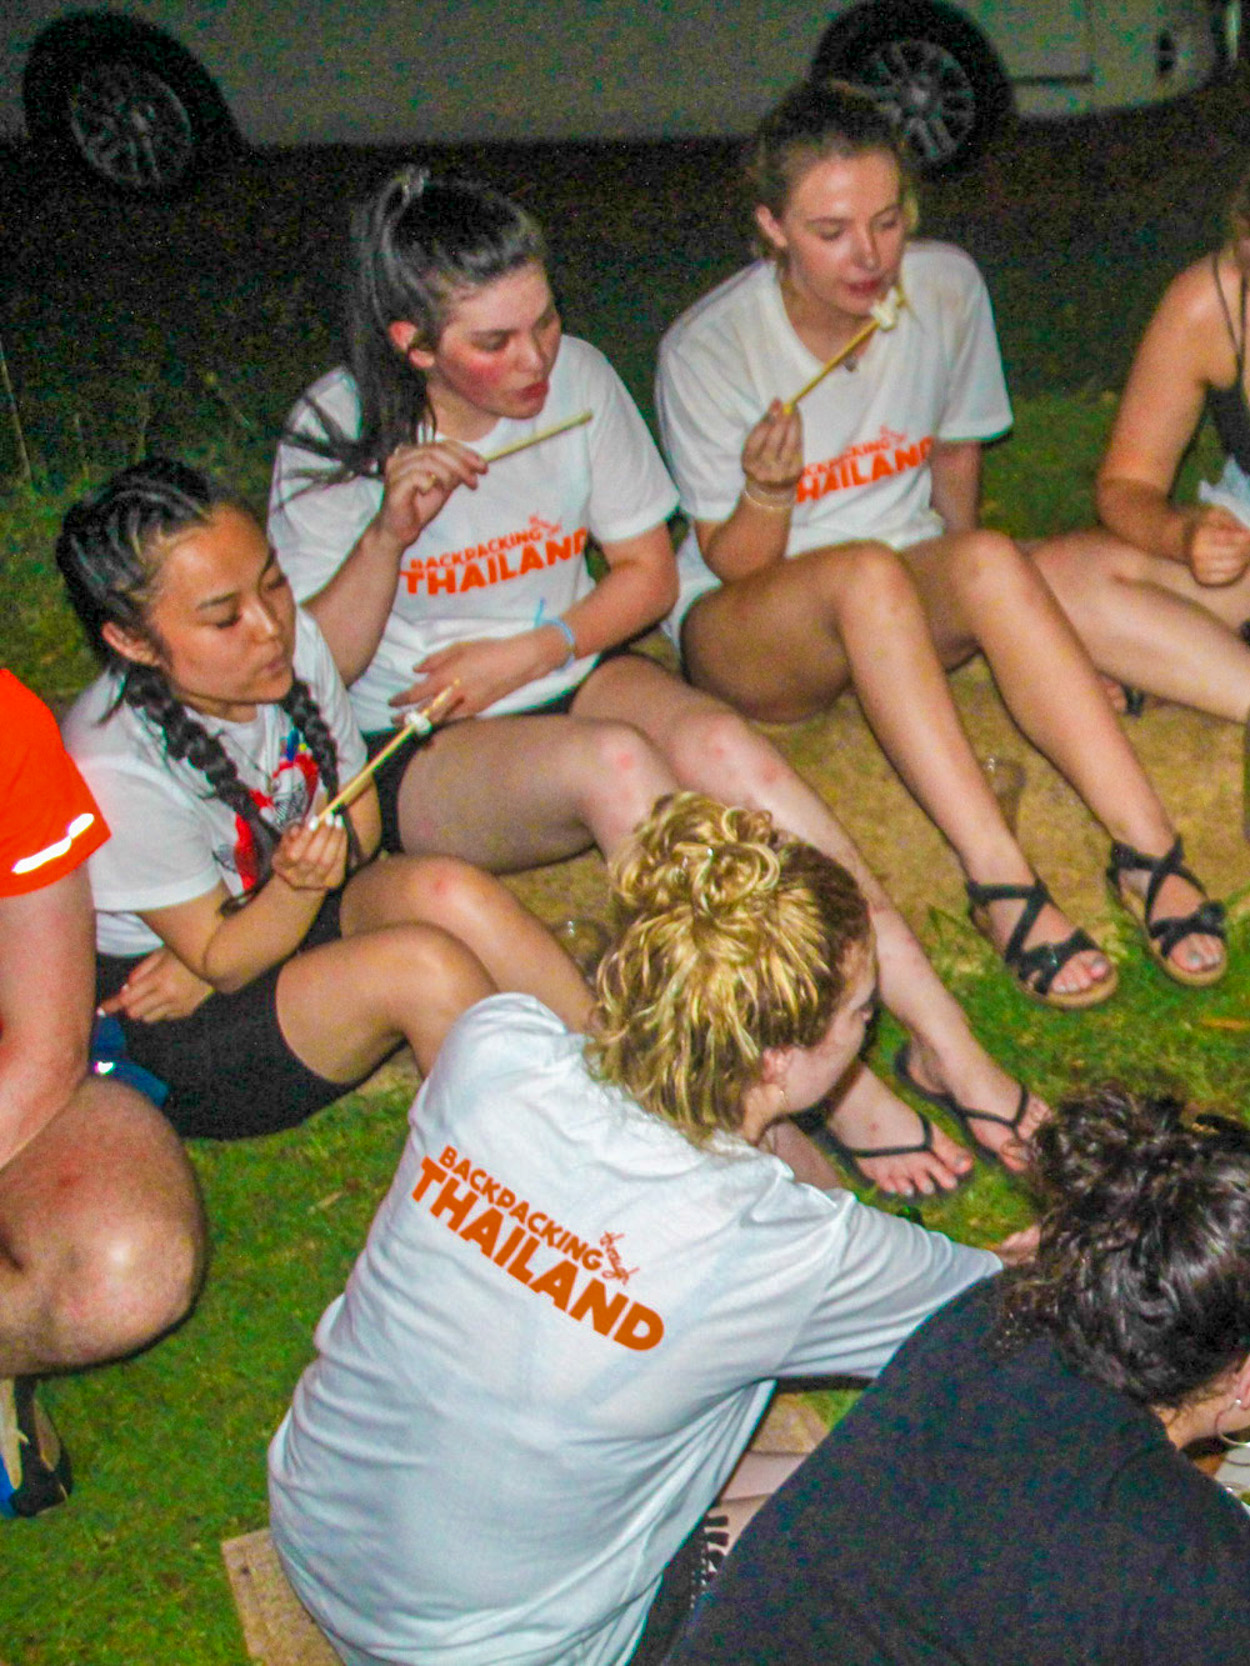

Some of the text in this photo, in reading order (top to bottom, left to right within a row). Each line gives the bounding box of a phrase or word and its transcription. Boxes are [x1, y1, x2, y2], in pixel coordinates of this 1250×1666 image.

[795, 435, 934, 504] HAILAN
[410, 528, 542, 570] BACKPACKING
[411, 1156, 665, 1352] THAILAND
[438, 1145, 603, 1272] BACKPACKING
